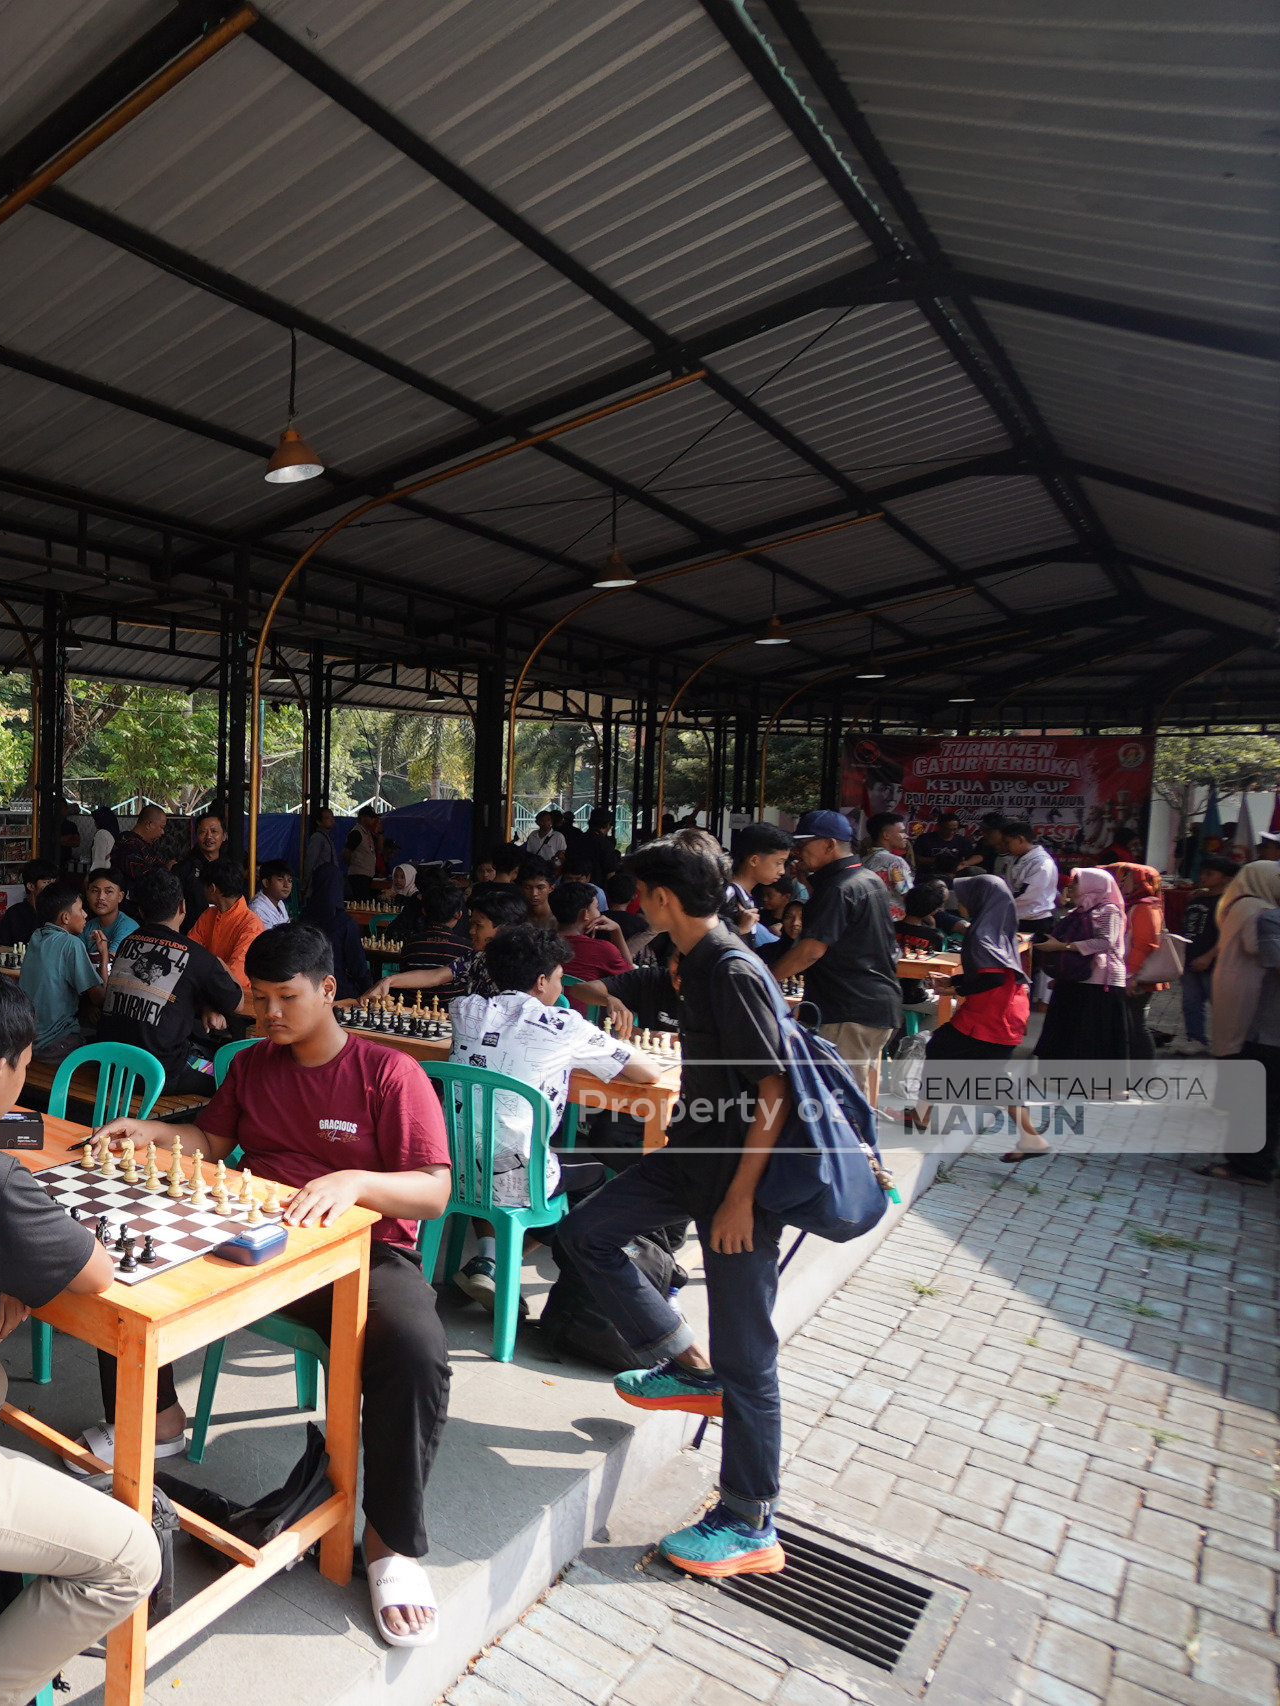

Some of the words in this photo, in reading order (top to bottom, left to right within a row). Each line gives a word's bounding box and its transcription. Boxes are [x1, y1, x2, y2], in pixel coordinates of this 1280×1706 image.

[941, 742, 1056, 757] TURNAMEN
[914, 757, 979, 777] CATUR
[984, 757, 1081, 779] TERBUKA
[925, 779, 984, 792] KETUA
[990, 780, 1028, 793] DPC
[1032, 780, 1071, 793] CUP
[905, 793, 925, 805] PDI
[927, 793, 1005, 807] PERJUANGAN
[1008, 795, 1036, 807] KOTA
[1040, 795, 1085, 807] MADIUN
[1032, 824, 1079, 842] FEST
[159, 939, 188, 951] STUDIO
[318, 1119, 358, 1134] GRACIOUS
